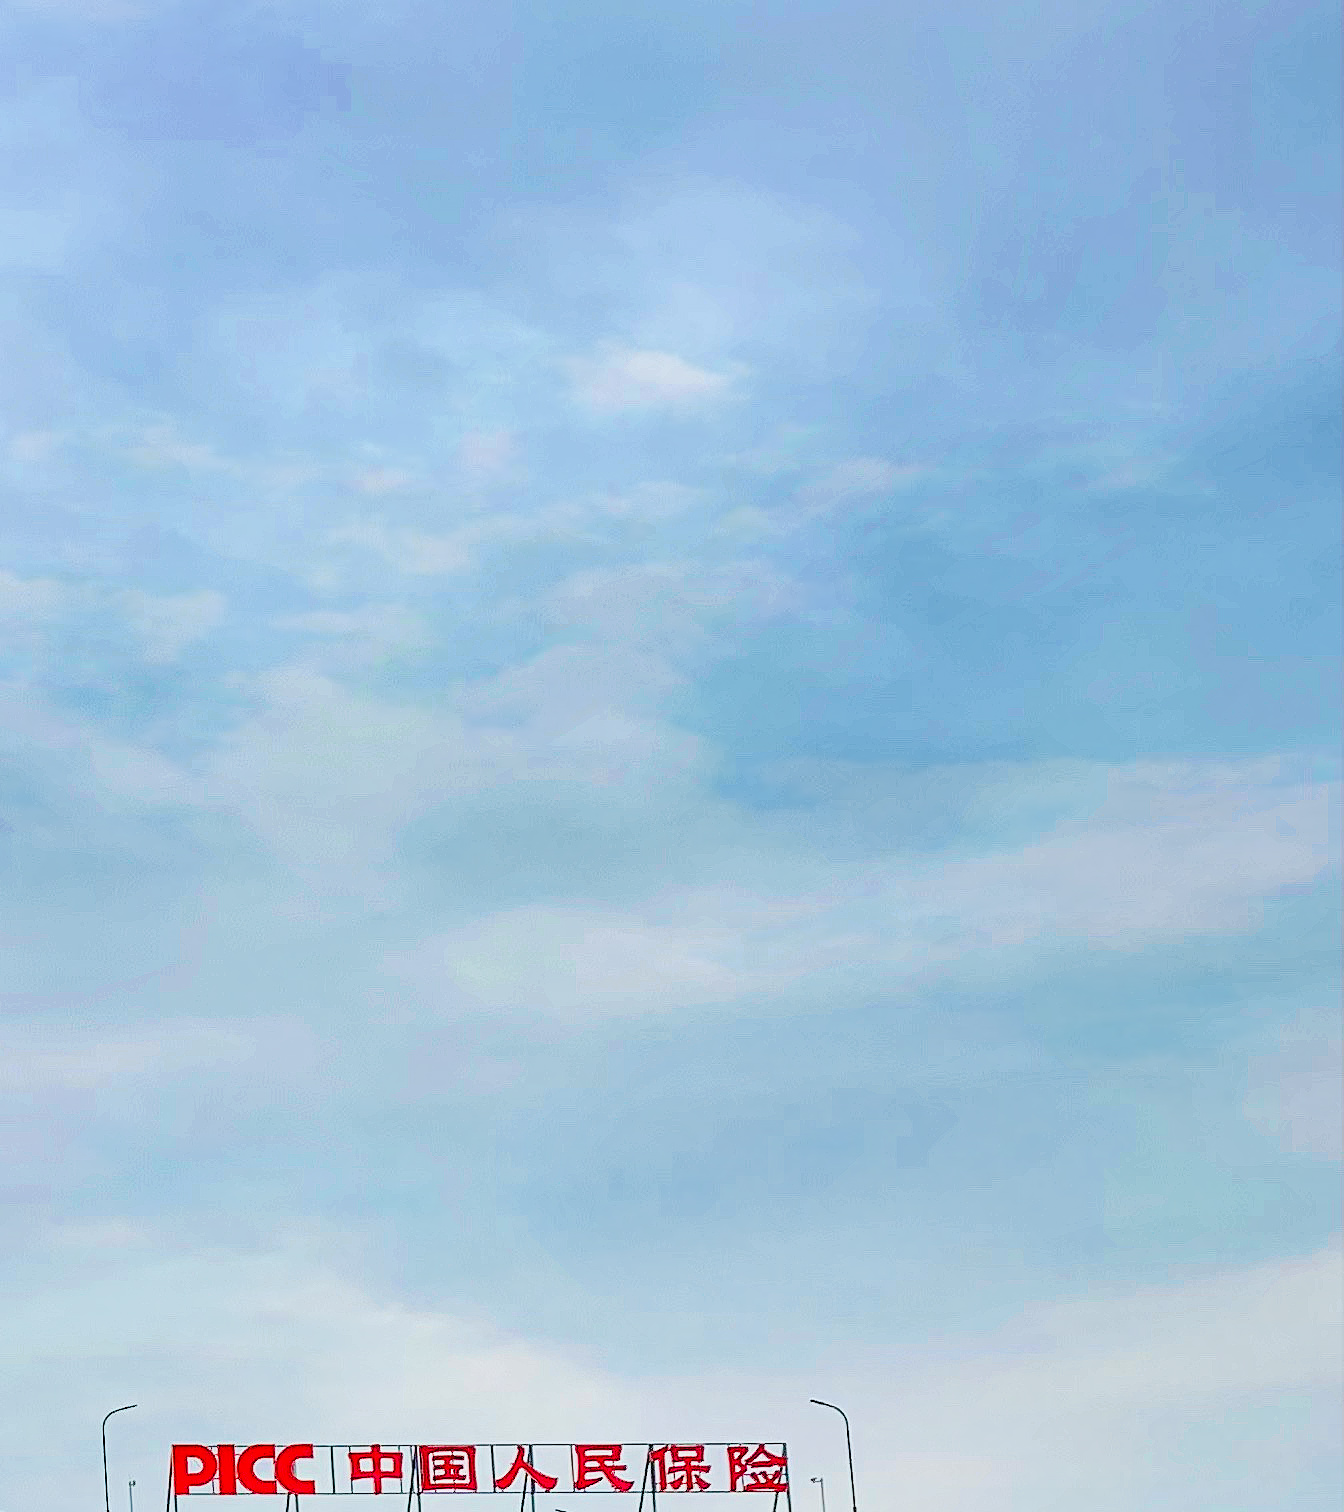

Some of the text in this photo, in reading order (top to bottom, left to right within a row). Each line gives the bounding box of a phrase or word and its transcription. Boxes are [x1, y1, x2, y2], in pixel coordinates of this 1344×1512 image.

[173, 1444, 315, 1494] PICC
[348, 1444, 788, 1493] 中国人民保险
